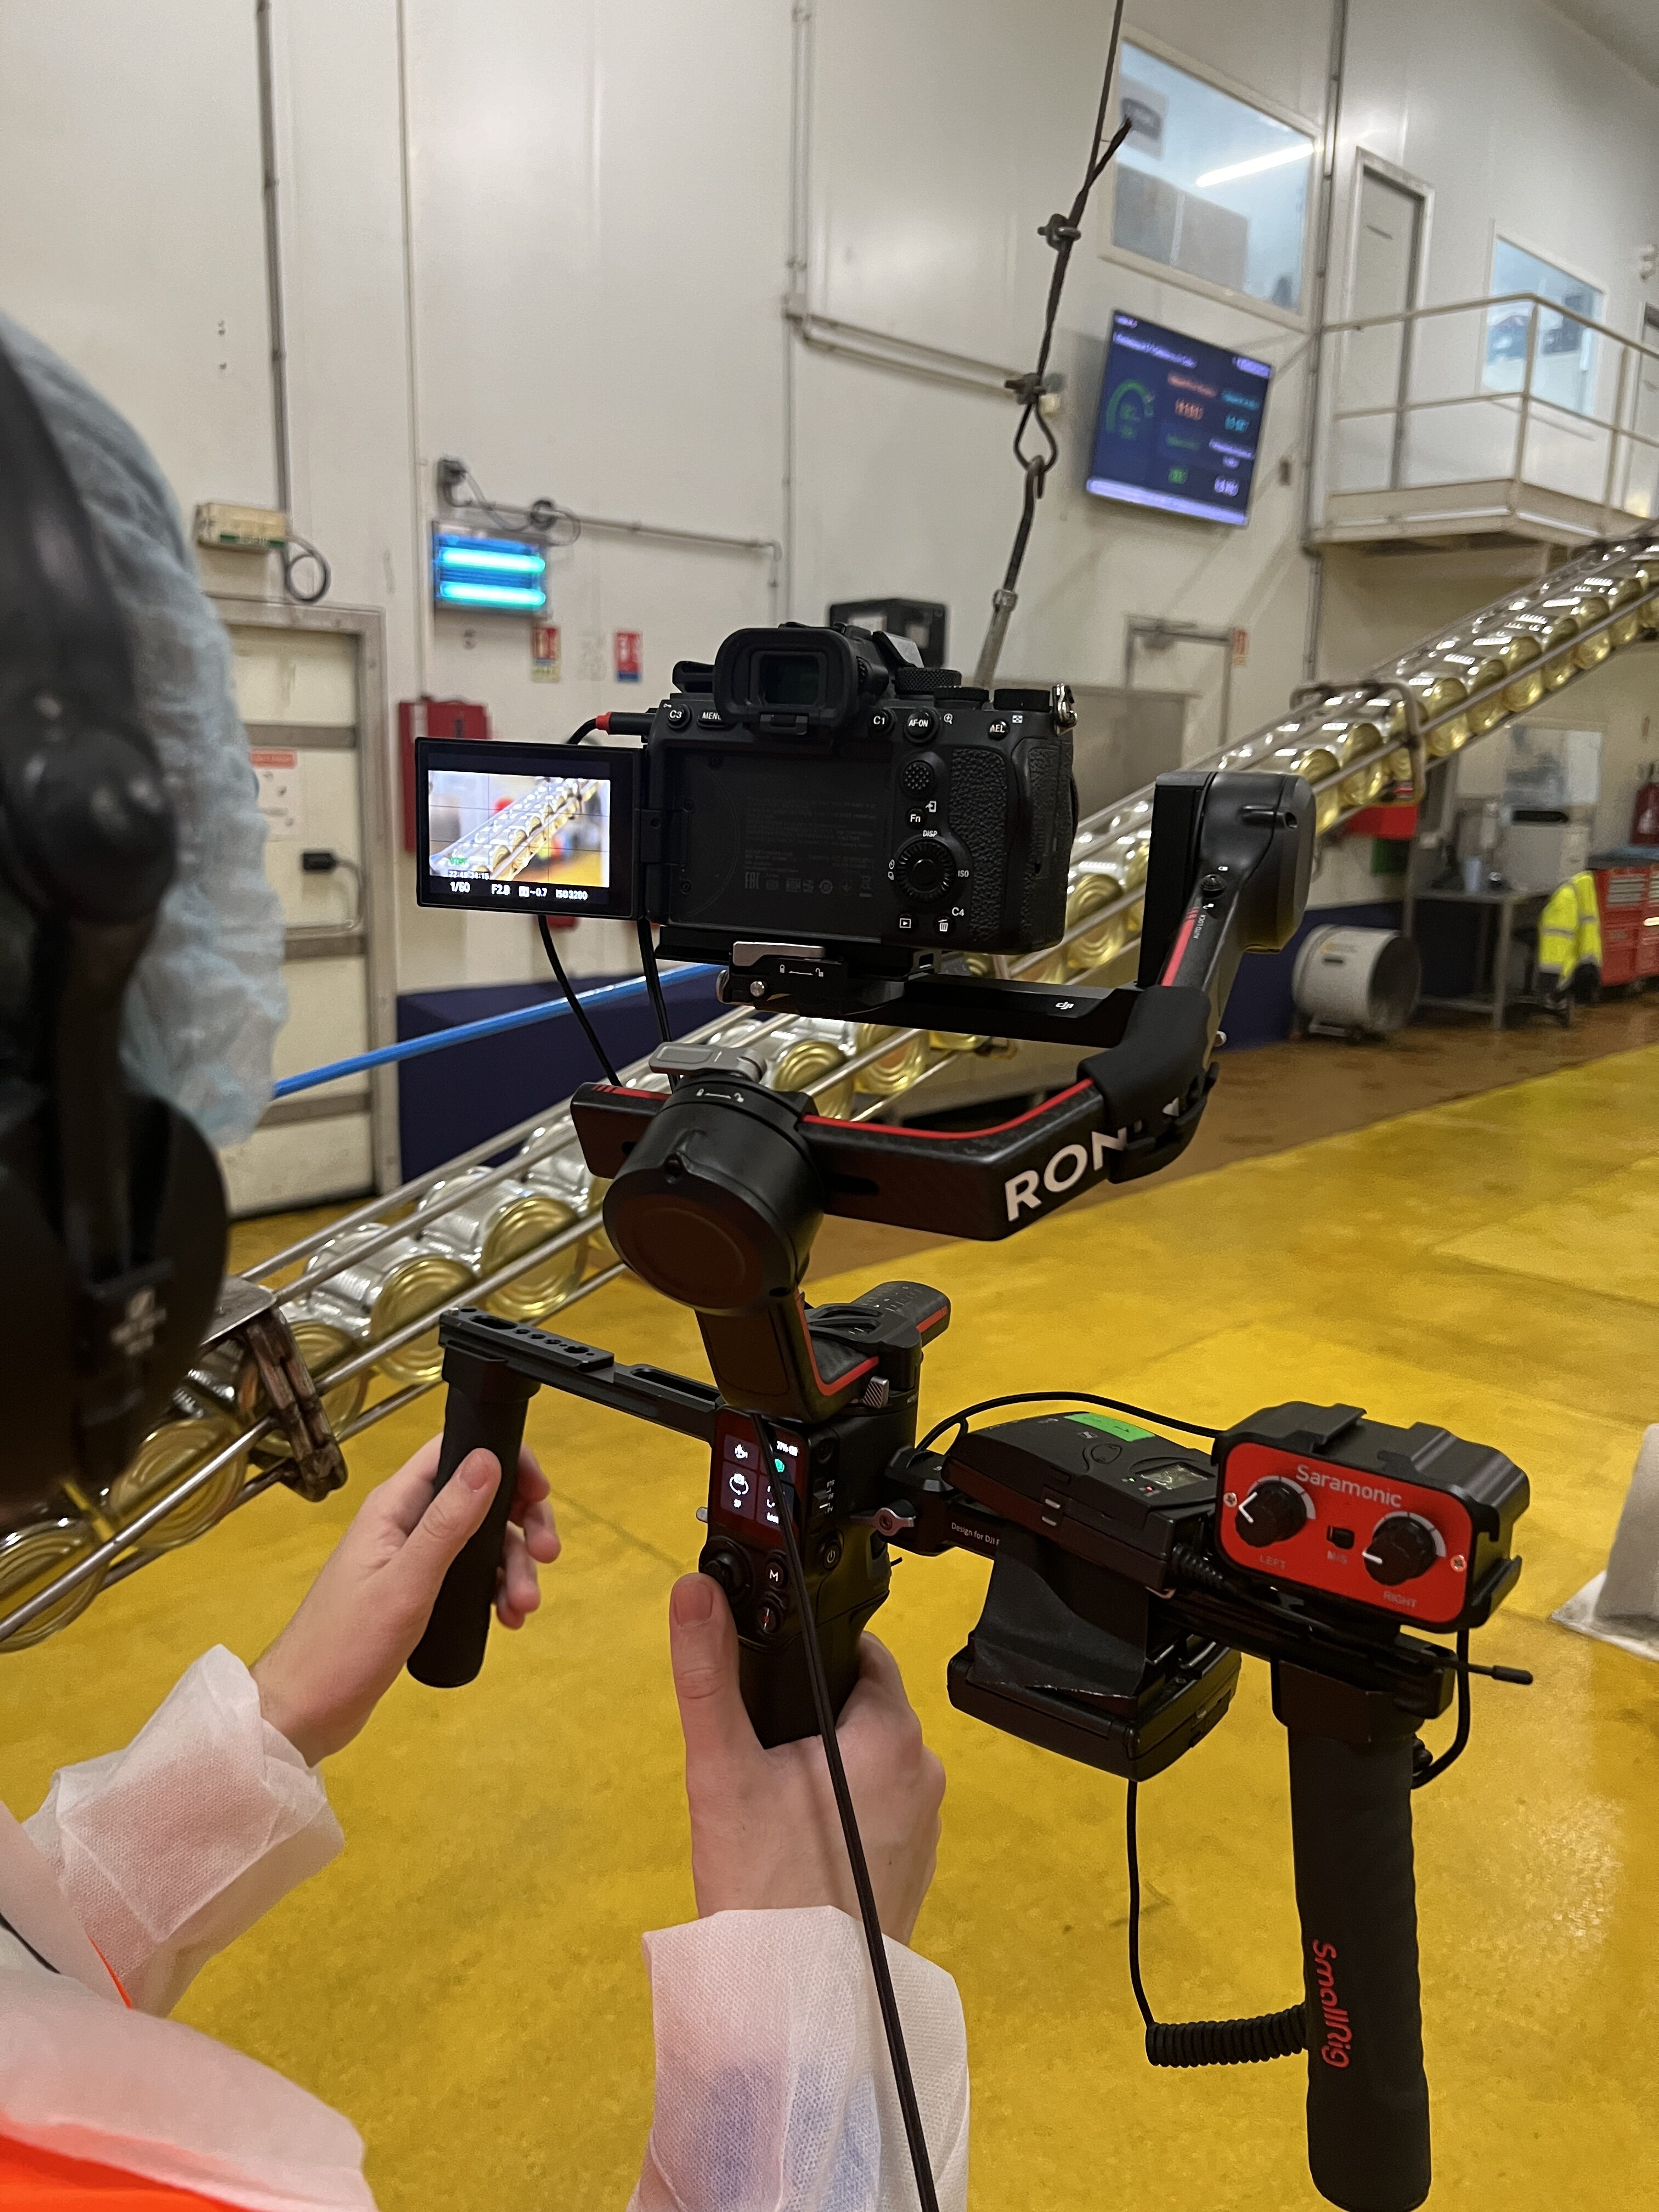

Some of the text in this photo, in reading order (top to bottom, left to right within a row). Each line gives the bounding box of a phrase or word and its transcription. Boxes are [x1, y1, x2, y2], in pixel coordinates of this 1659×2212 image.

[669, 709, 682, 719] C3
[873, 715, 885, 725] C1
[909, 719, 928, 727] AF-ON
[989, 724, 1005, 733] AEL
[910, 814, 921, 822] Fn
[923, 830, 938, 838] DISP
[952, 907, 964, 916] C4
[1296, 1463, 1402, 1508] Saramonic
[951, 1522, 973, 1536] Design
[974, 1530, 984, 1540] for
[985, 1534, 995, 1544] DJI
[1260, 1554, 1286, 1570] LEFT
[769, 1569, 778, 1582] M
[1383, 1590, 1417, 1607] RIGHT
